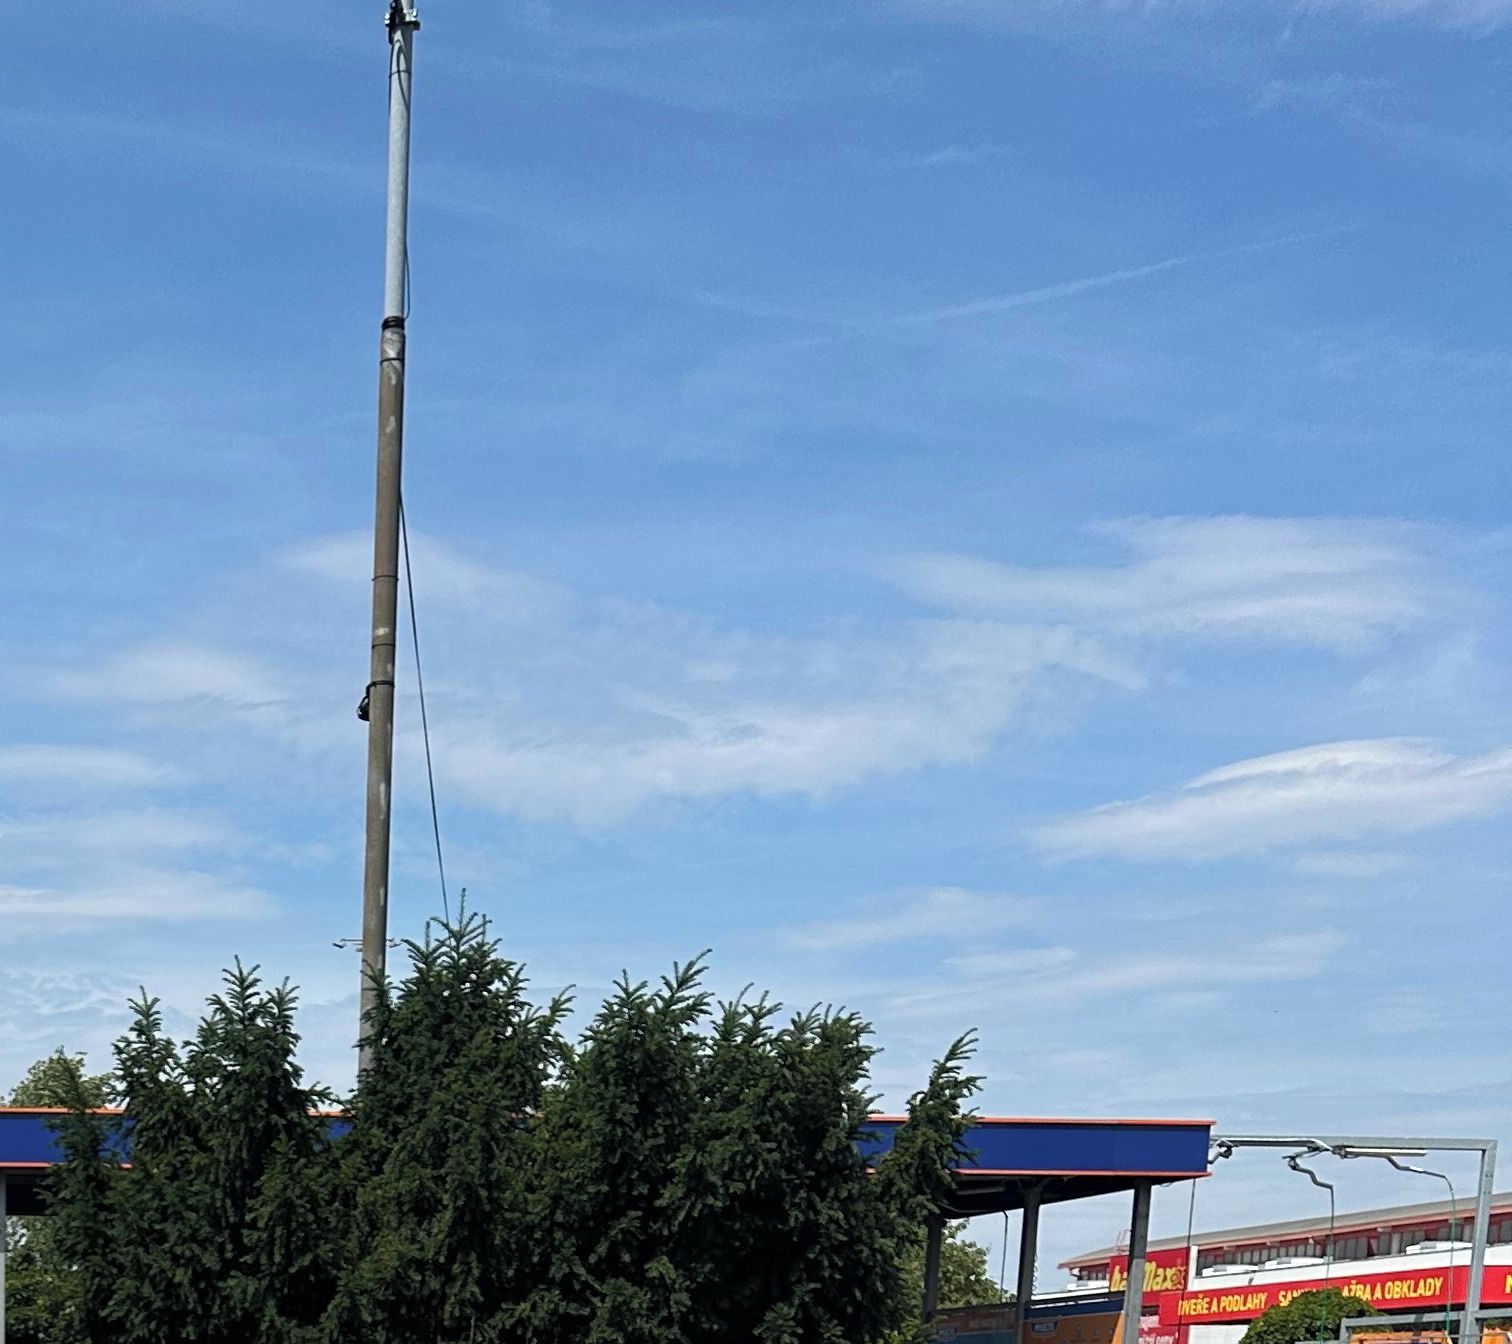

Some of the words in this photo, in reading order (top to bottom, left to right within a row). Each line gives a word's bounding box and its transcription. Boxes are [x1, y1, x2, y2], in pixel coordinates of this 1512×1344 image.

[1373, 1282, 1383, 1301] A
[1385, 1276, 1443, 1299] OBKLADY
[1210, 1301, 1219, 1314] A
[1220, 1292, 1267, 1313] PODLAHY
